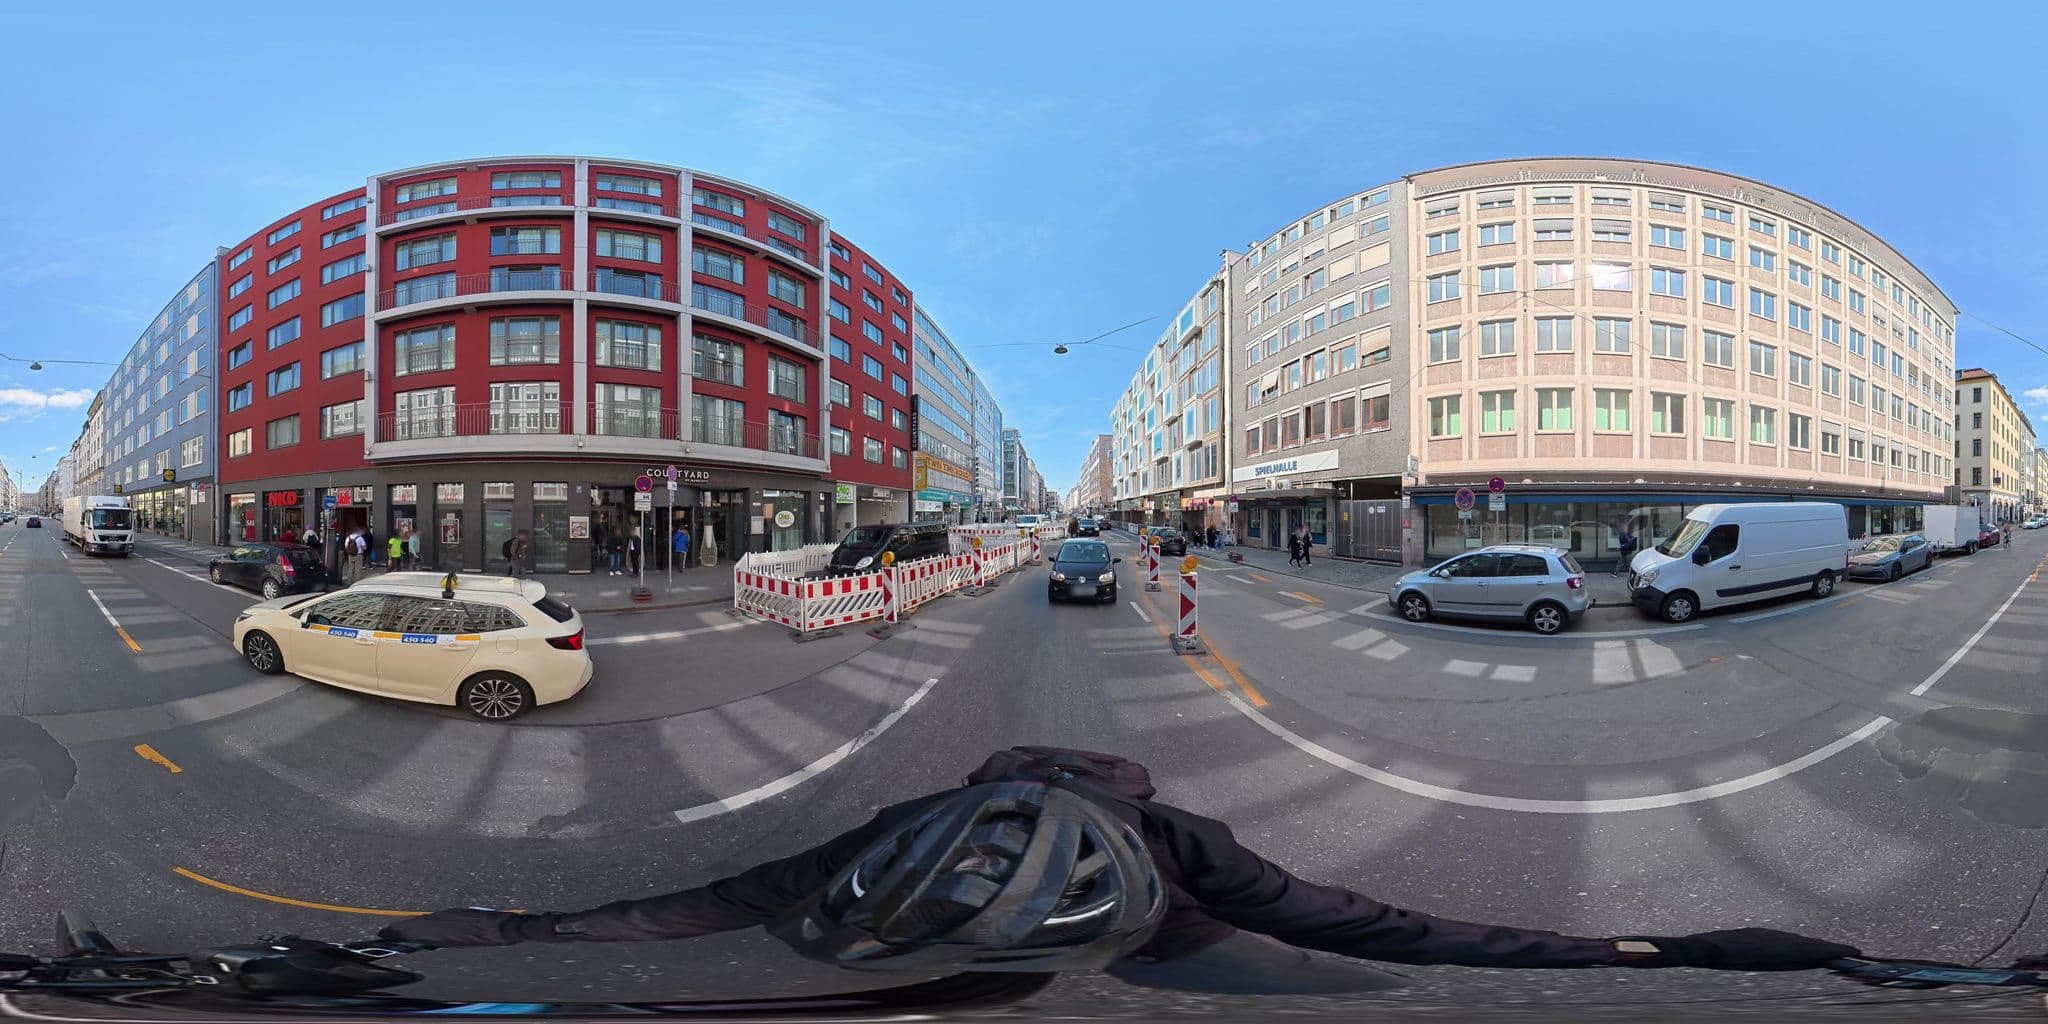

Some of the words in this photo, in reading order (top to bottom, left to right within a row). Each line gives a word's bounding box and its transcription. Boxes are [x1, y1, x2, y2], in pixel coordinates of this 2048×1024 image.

[646, 468, 710, 479] COUTYARD
[1255, 460, 1298, 476] SPIELHALLE
[268, 491, 298, 507] NKD
